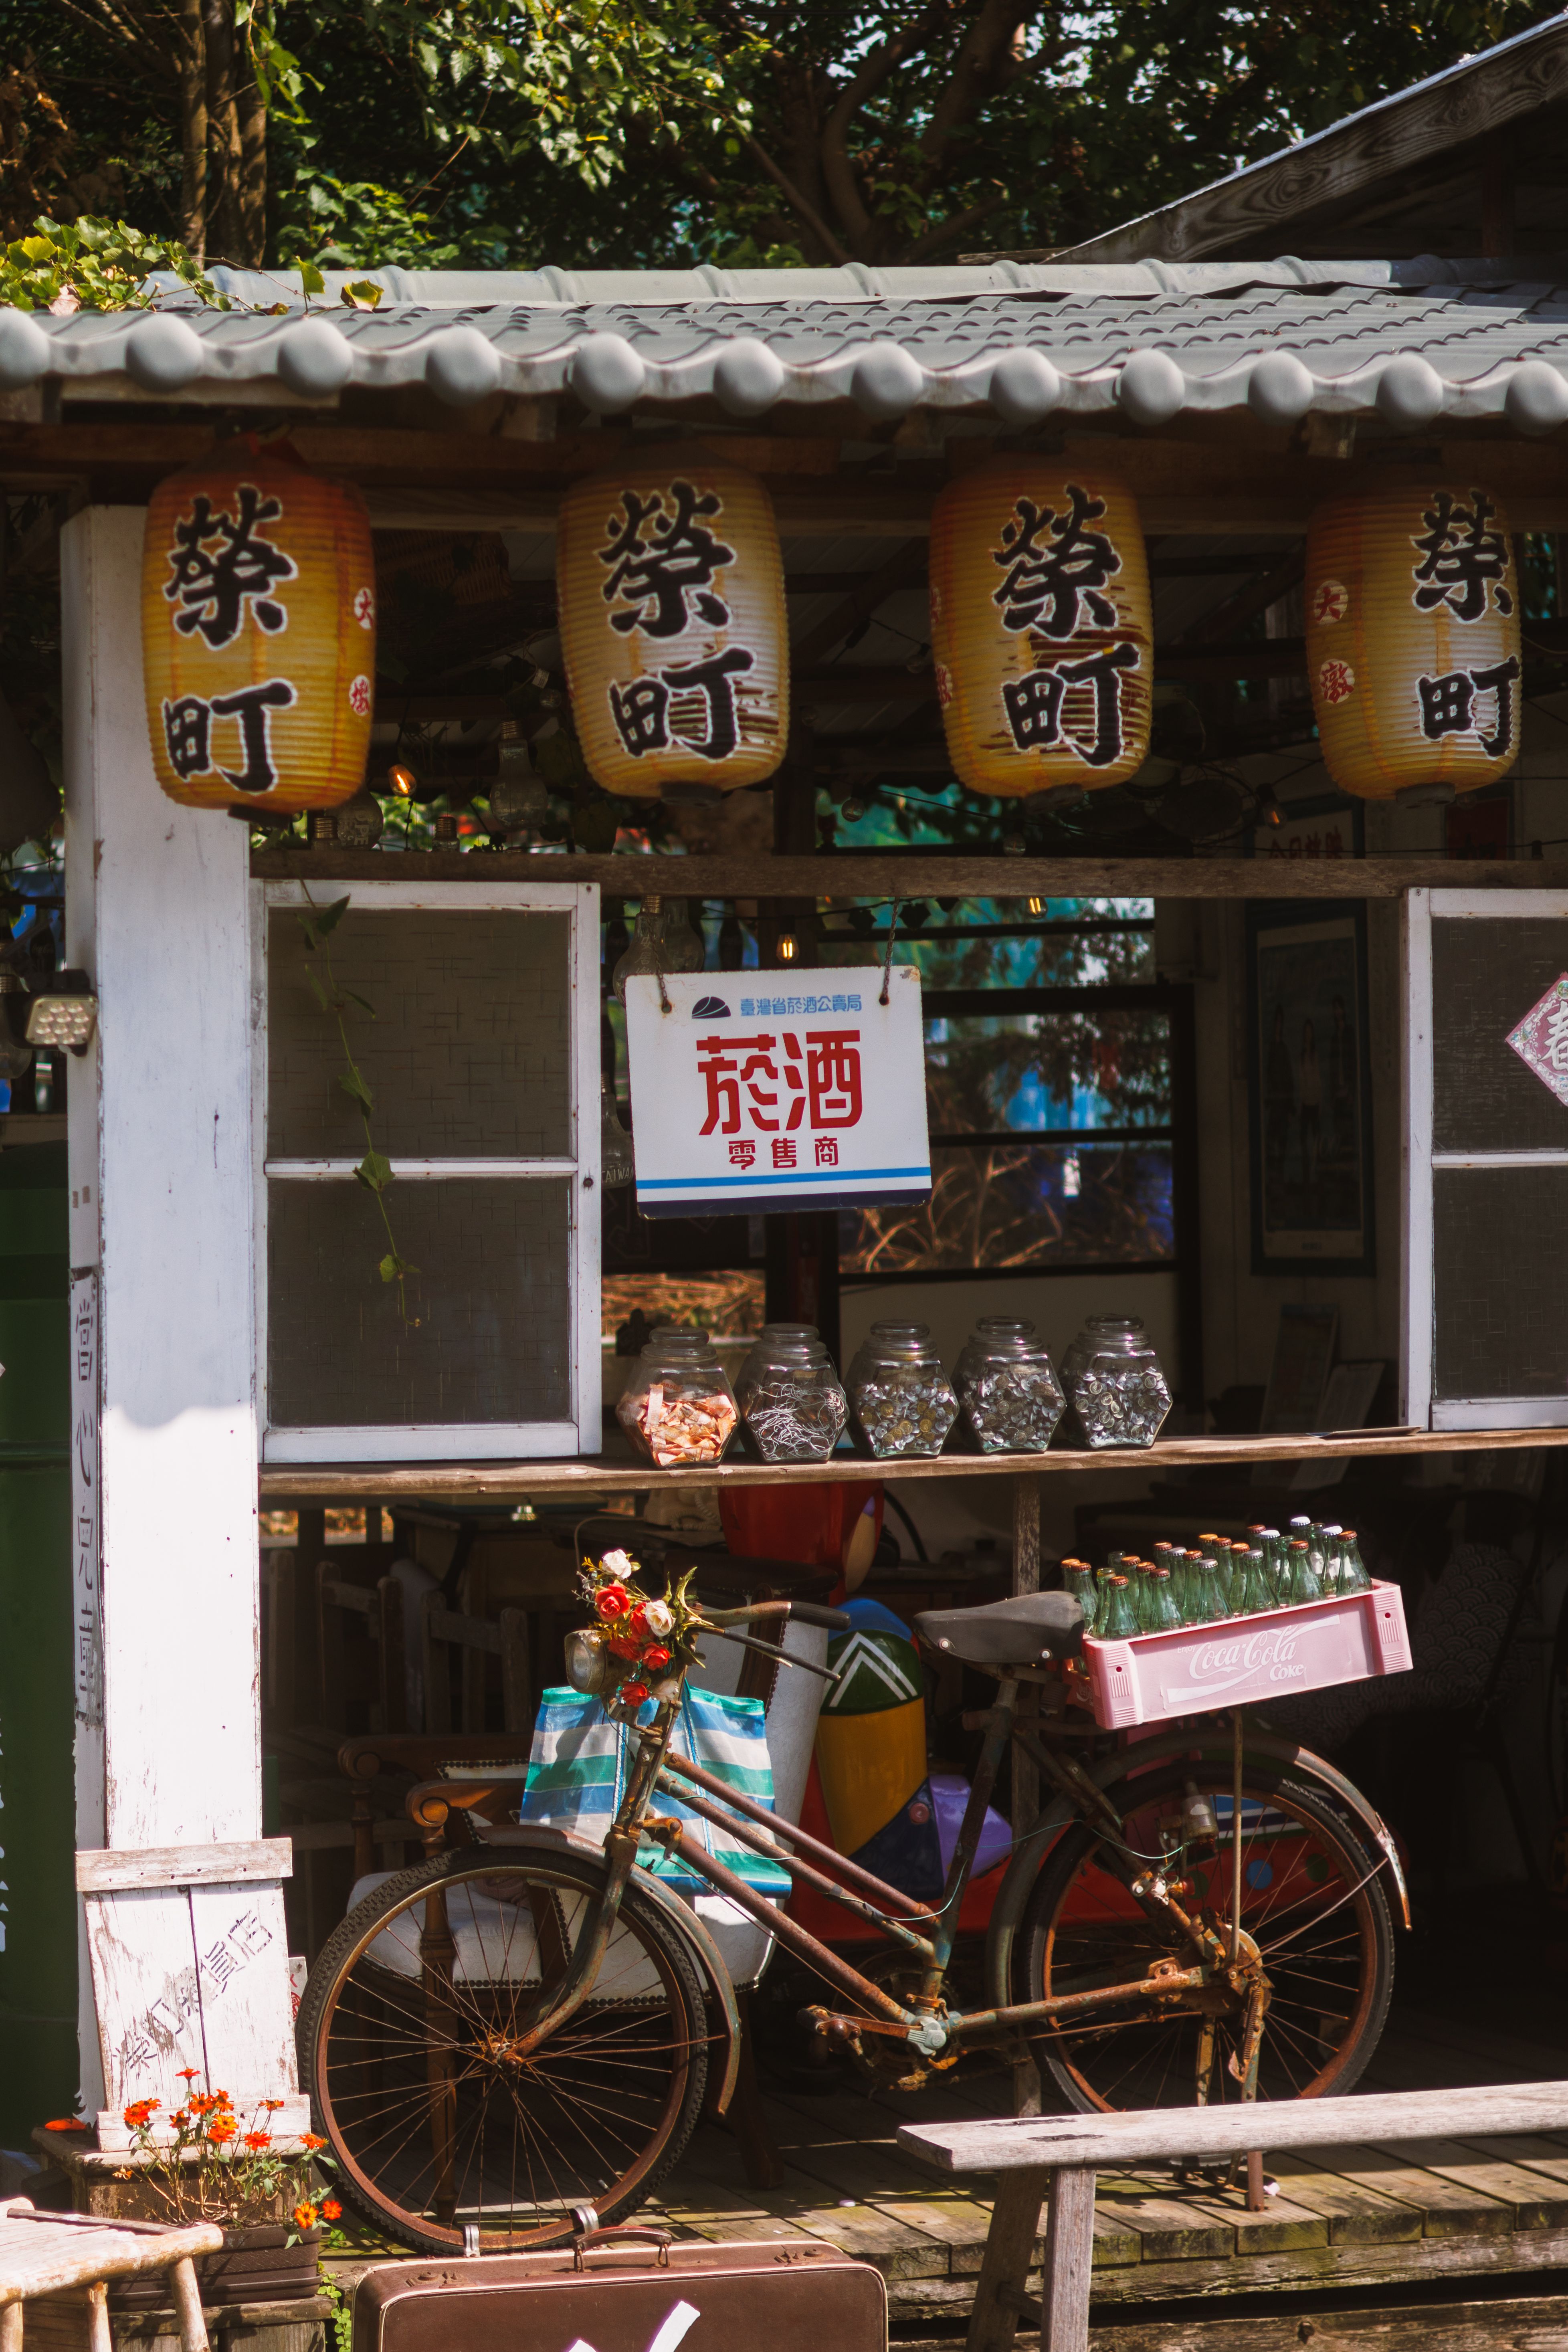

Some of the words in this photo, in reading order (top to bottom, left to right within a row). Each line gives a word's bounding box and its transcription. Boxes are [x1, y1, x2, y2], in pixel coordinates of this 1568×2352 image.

[163, 482, 299, 794] 榮町
[593, 477, 759, 761] 榮町
[990, 481, 1144, 770] 榮町
[1408, 486, 1523, 762] 榮町
[740, 994, 862, 1016] 臺灣省菸酒公賣局
[696, 1029, 863, 1136] 菸酒
[601, 1166, 634, 1183] AIWAN
[729, 1136, 839, 1170] 零售商
[1177, 1645, 1196, 1654] Enjoy
[1189, 1625, 1299, 1679] Coca-Cola
[1269, 1664, 1304, 1681] Coke
